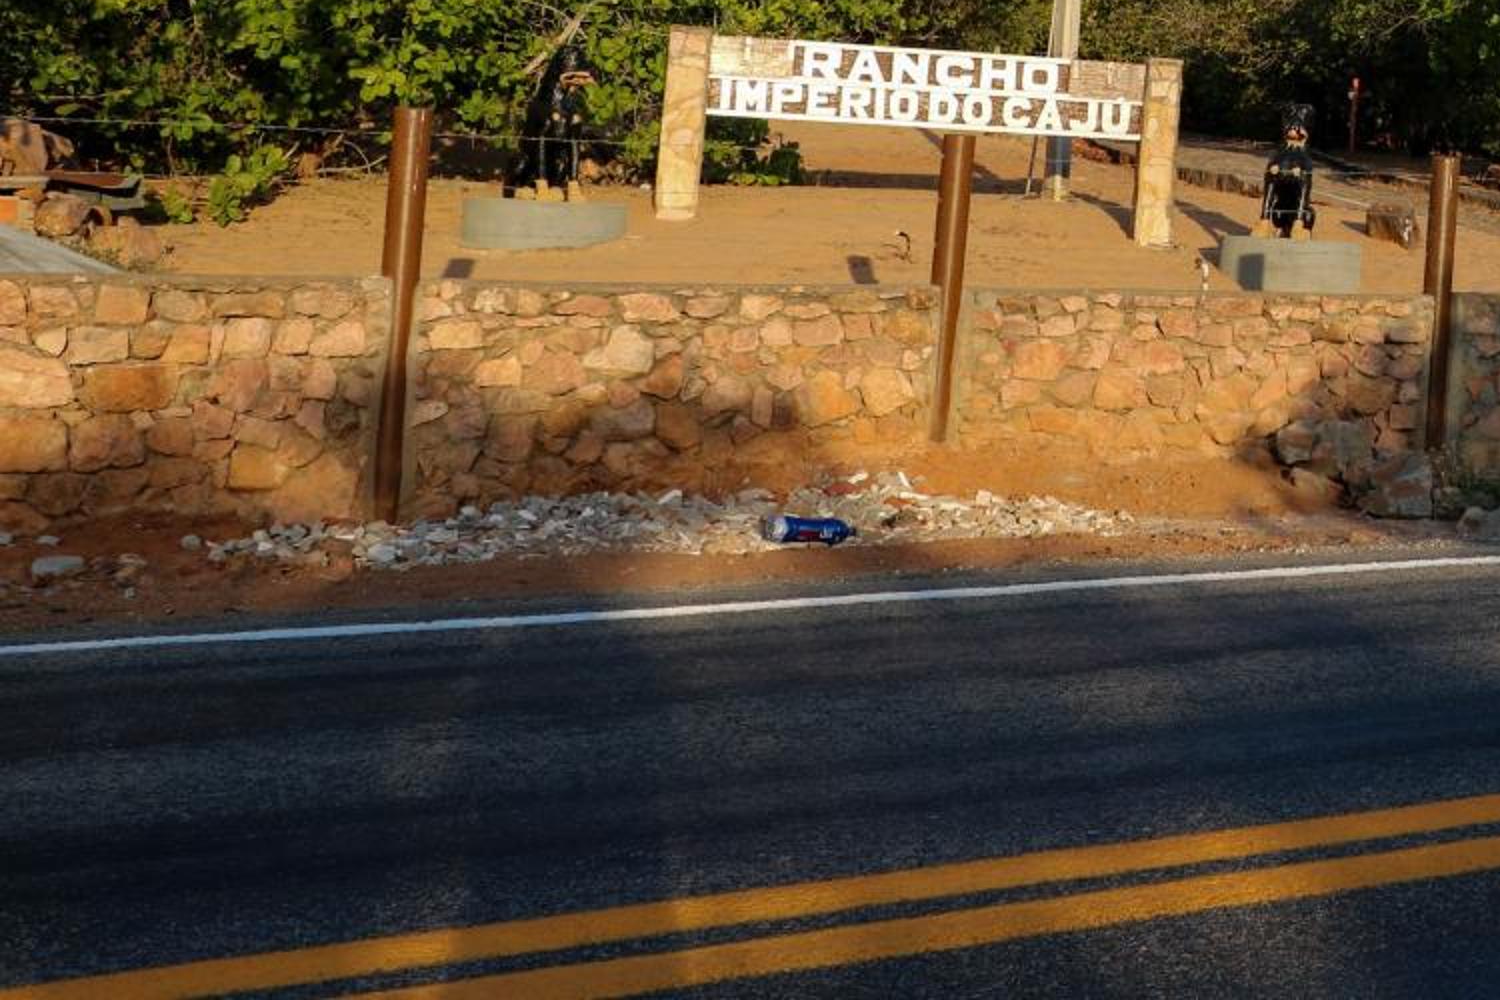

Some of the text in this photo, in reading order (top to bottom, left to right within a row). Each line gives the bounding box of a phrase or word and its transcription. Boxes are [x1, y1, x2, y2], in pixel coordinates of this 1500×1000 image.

[802, 46, 1058, 92] RANCHO
[720, 79, 918, 120] IMPERIO
[928, 90, 992, 125] DO
